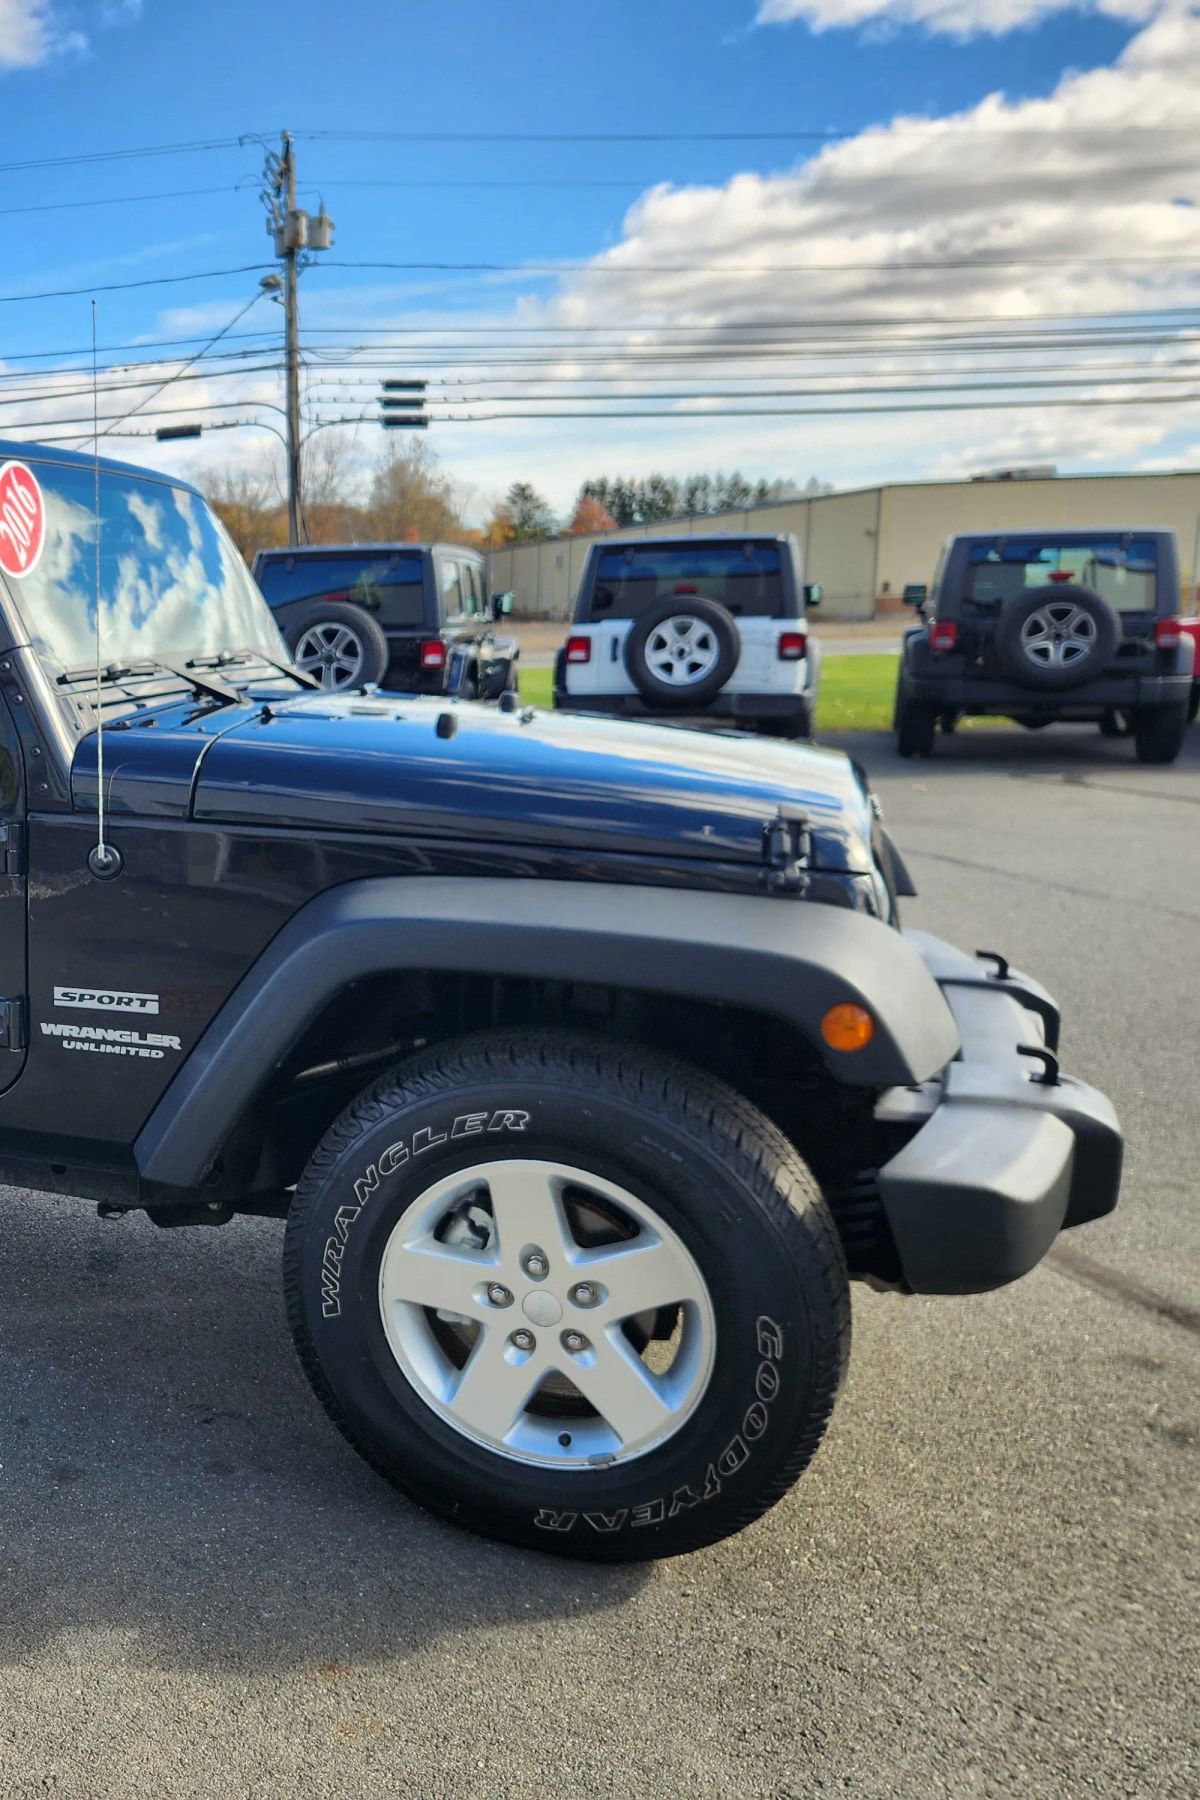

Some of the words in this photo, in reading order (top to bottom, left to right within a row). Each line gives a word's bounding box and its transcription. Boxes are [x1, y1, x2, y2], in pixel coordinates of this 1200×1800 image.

[60, 991, 151, 1008] SPORT
[40, 1022, 182, 1050] WRANGLER
[61, 1040, 165, 1059] UNLIMITED
[321, 1109, 530, 1318] WRANGLER
[533, 1315, 783, 1532] GOODYEAR
